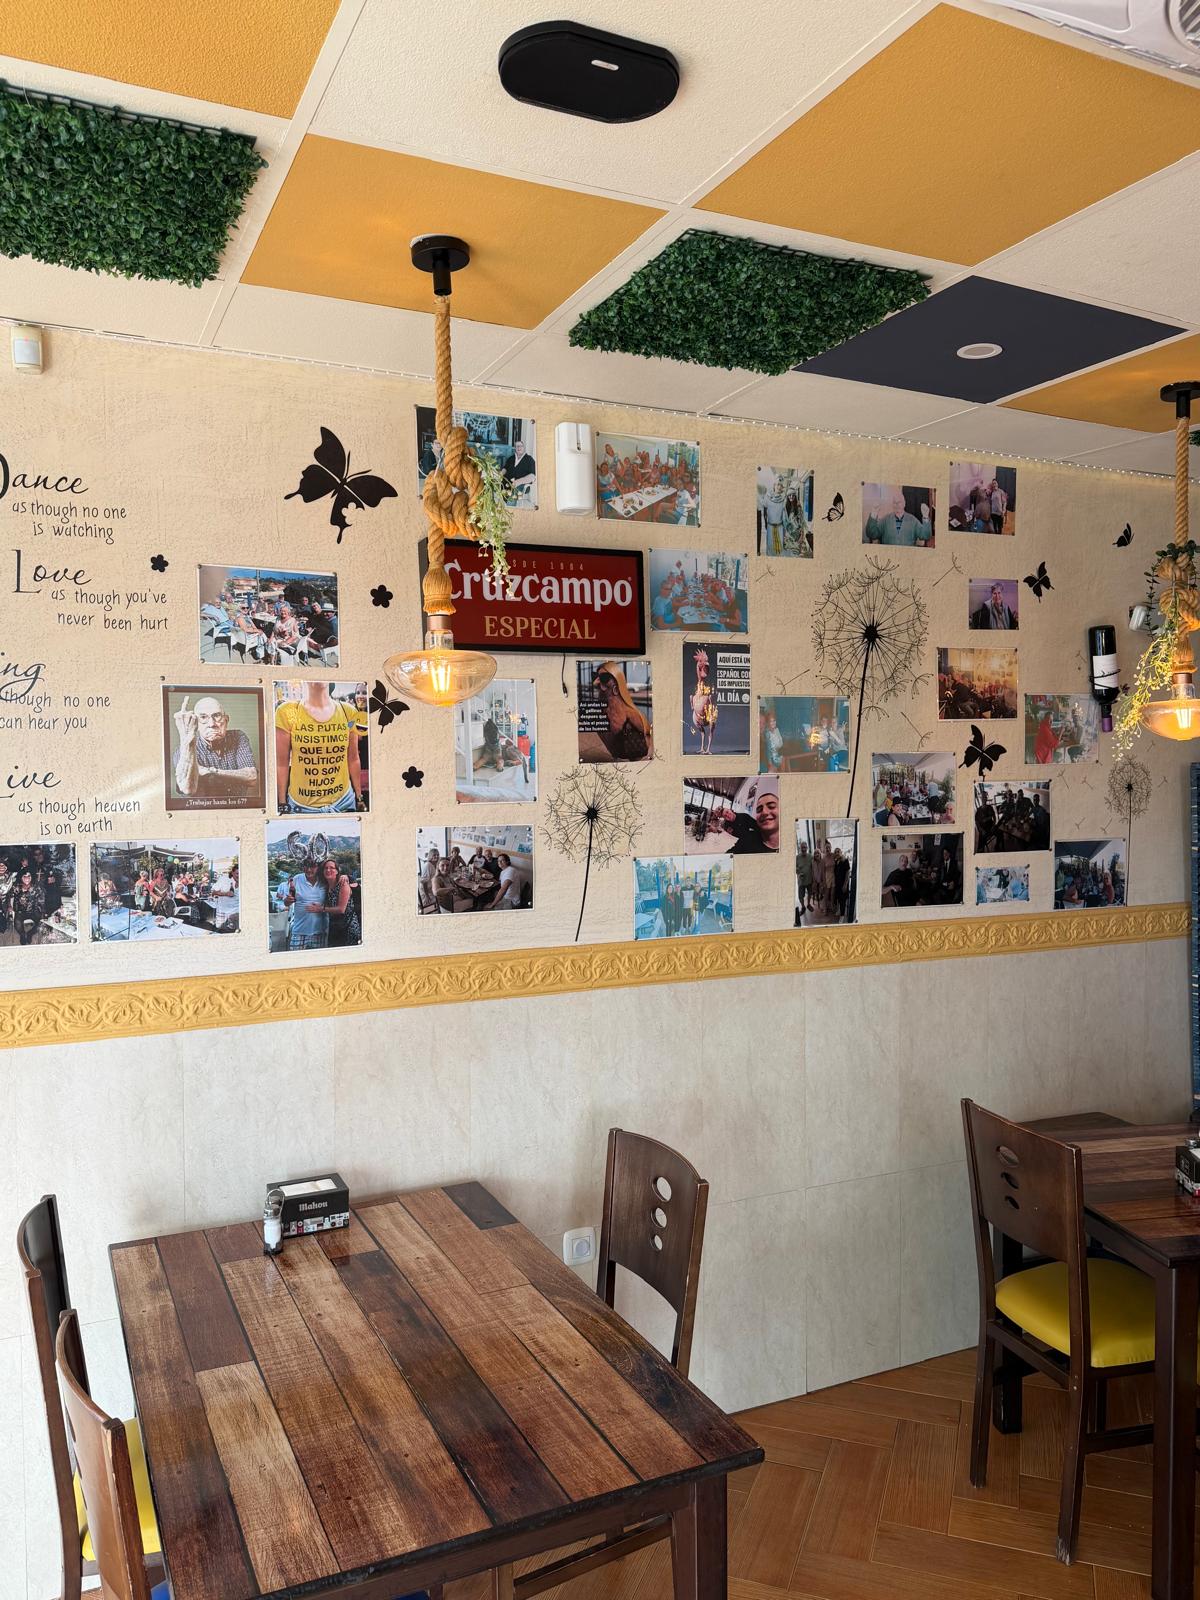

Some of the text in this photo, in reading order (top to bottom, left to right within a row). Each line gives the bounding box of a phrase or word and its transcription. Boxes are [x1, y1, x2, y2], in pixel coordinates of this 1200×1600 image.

[0, 453, 88, 500] ance
[12, 501, 127, 524] as though no one
[33, 521, 114, 545] is watching
[11, 549, 92, 594] Love
[444, 558, 633, 612] Cruzcampo
[51, 588, 167, 612] as though you've
[57, 612, 168, 631] never been hurt
[483, 615, 597, 641] ESPECIAL
[719, 654, 730, 664] AQUÍ
[731, 655, 743, 664] ESTÁ
[717, 668, 740, 679] ESPAÑOL
[726, 680, 750, 688] IMPUESTOS
[5, 688, 111, 713] though no one
[717, 689, 740, 703] AL DÍA
[28, 714, 59, 730] hear
[64, 717, 88, 735] you
[295, 723, 347, 732] LAS PUTAS
[295, 734, 348, 743] INSISTIMOS
[298, 754, 345, 765] POLÍTICOS
[300, 745, 345, 755] QUE LOS
[304, 766, 341, 776] NO SON
[0, 765, 61, 799] ive
[298, 784, 344, 797] NUESTROS
[309, 777, 335, 787] HIJOS
[18, 797, 140, 820] as though heaven
[40, 817, 113, 836] is on earth
